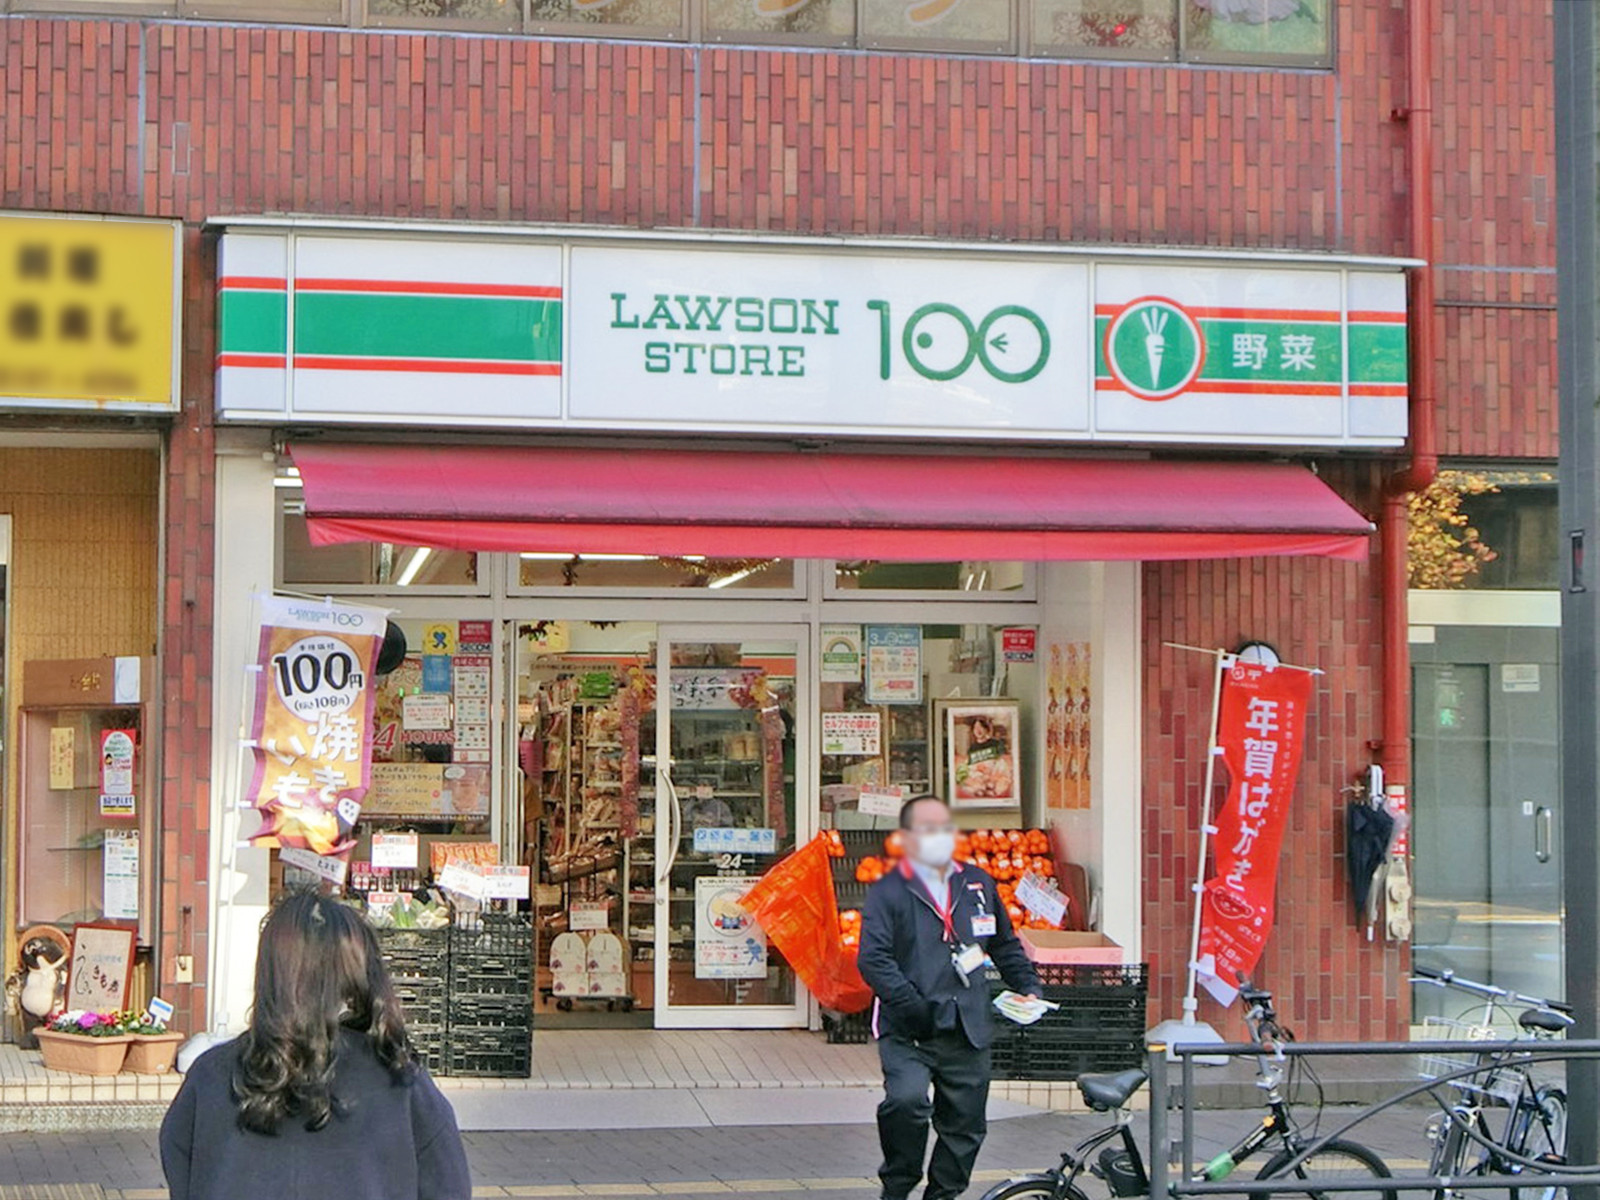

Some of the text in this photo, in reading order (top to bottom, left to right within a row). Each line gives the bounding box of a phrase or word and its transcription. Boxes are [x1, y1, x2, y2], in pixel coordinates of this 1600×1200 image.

[610, 293, 1052, 384] LAWSON 100
[1231, 332, 1317, 371] 野菜
[644, 341, 806, 377] STORE
[332, 612, 364, 627] 100
[400, 731, 456, 744] HOURS
[1226, 696, 1280, 892] 年賀はがき
[720, 853, 743, 869] 24
